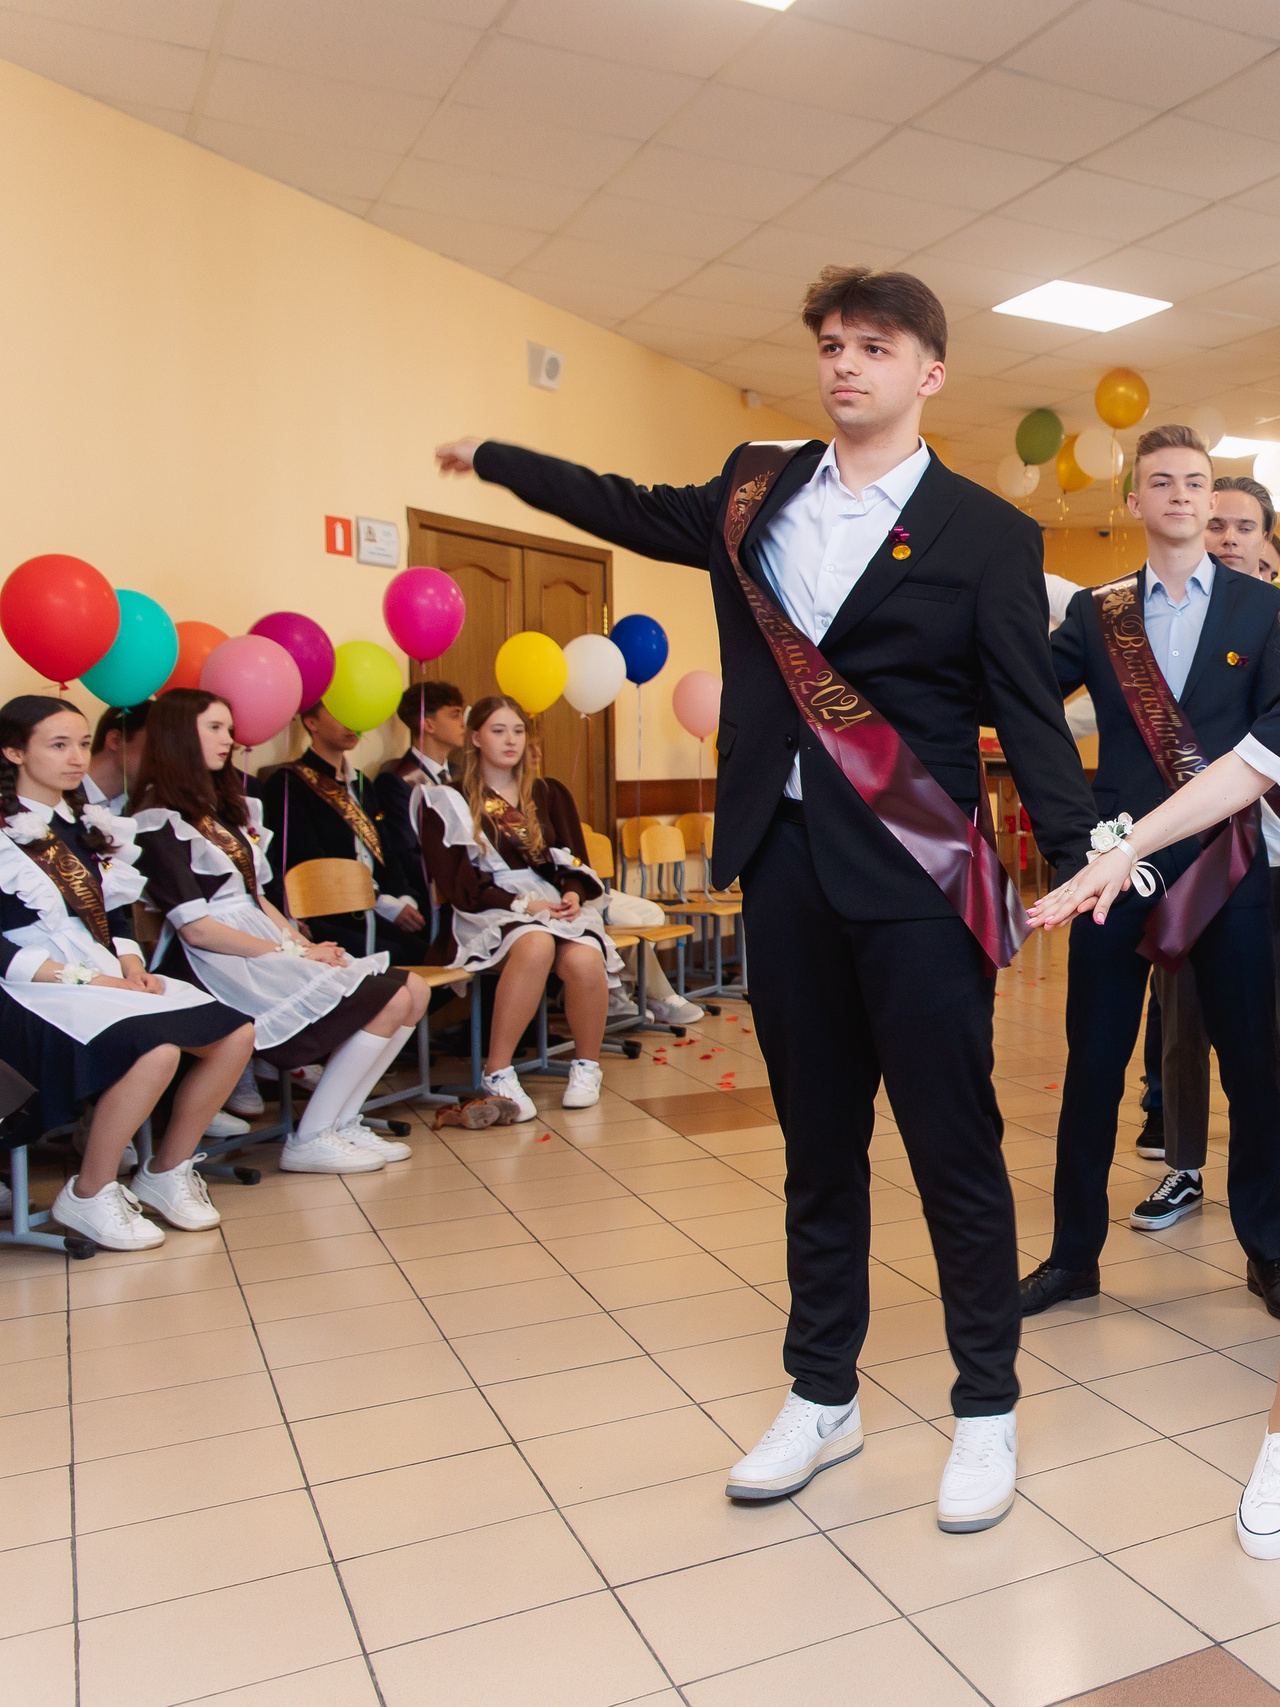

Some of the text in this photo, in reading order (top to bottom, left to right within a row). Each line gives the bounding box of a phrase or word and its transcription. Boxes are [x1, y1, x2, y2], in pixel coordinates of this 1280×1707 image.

[799, 670, 872, 732] 2024
[1114, 613, 1208, 782] Выпускник 202
